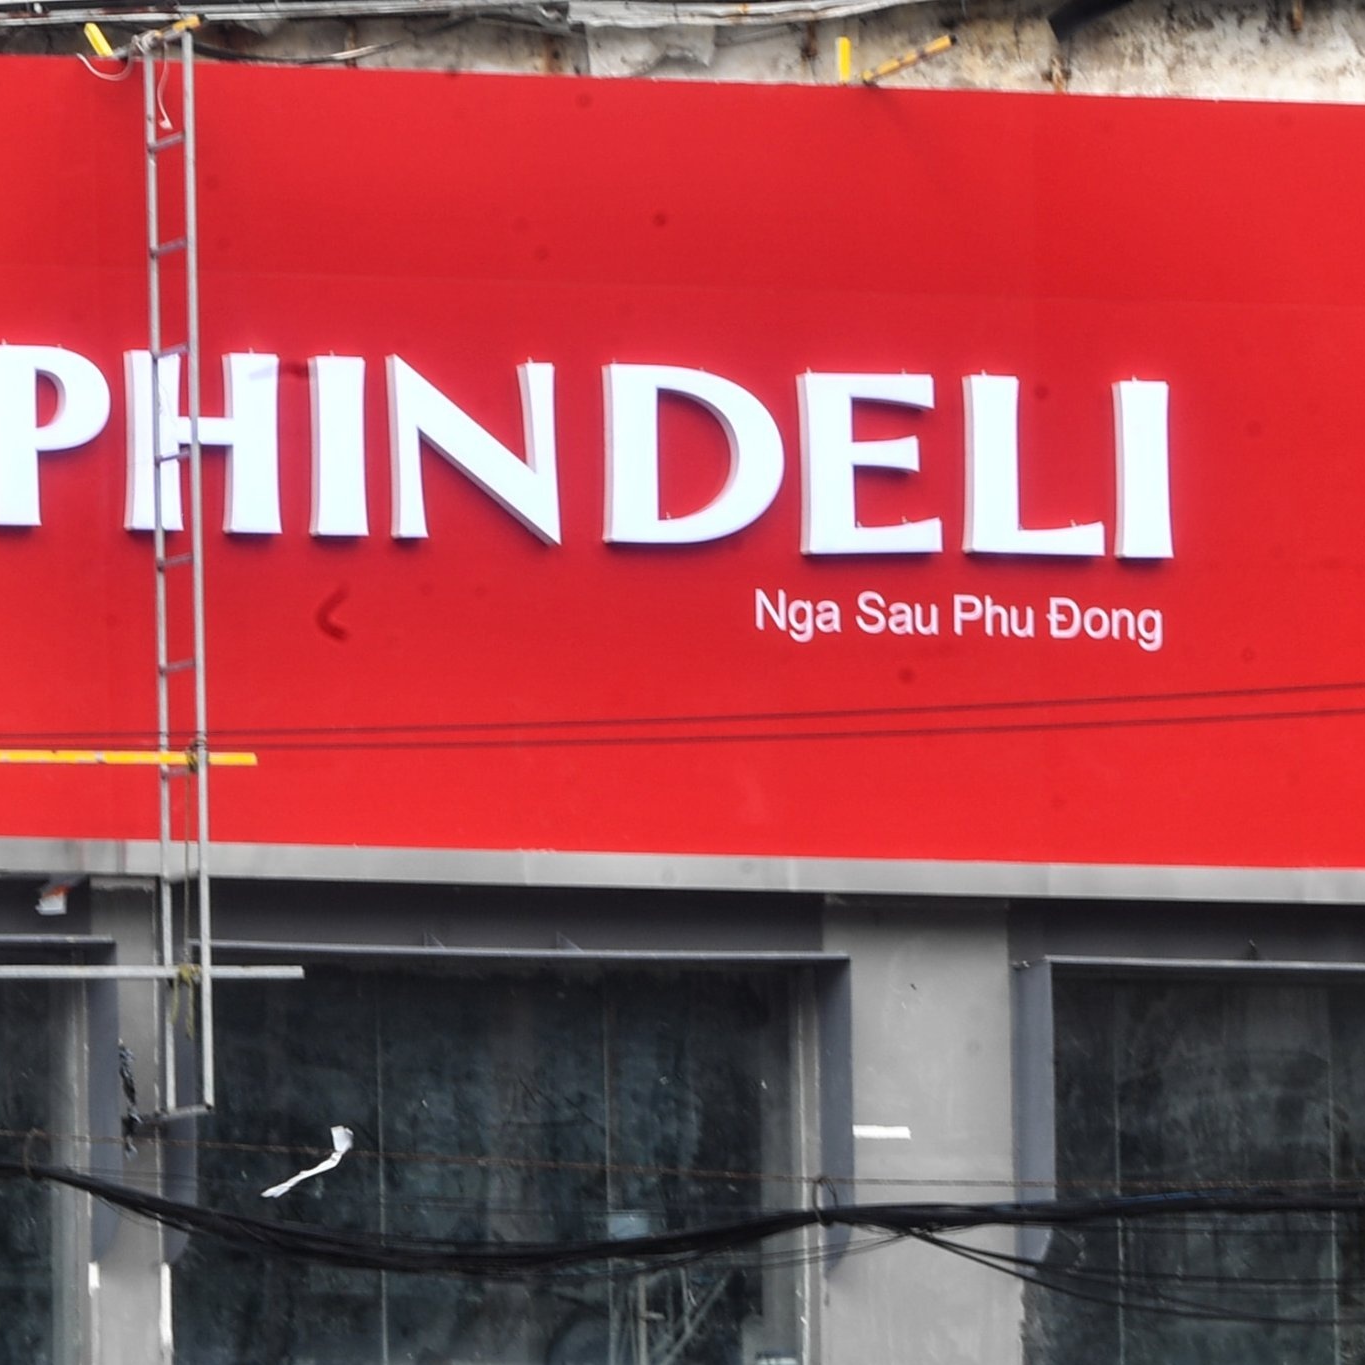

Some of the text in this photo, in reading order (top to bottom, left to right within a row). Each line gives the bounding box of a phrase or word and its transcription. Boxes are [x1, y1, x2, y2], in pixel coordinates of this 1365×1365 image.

[754, 588, 1164, 651] Nga Sau Phu Đong
